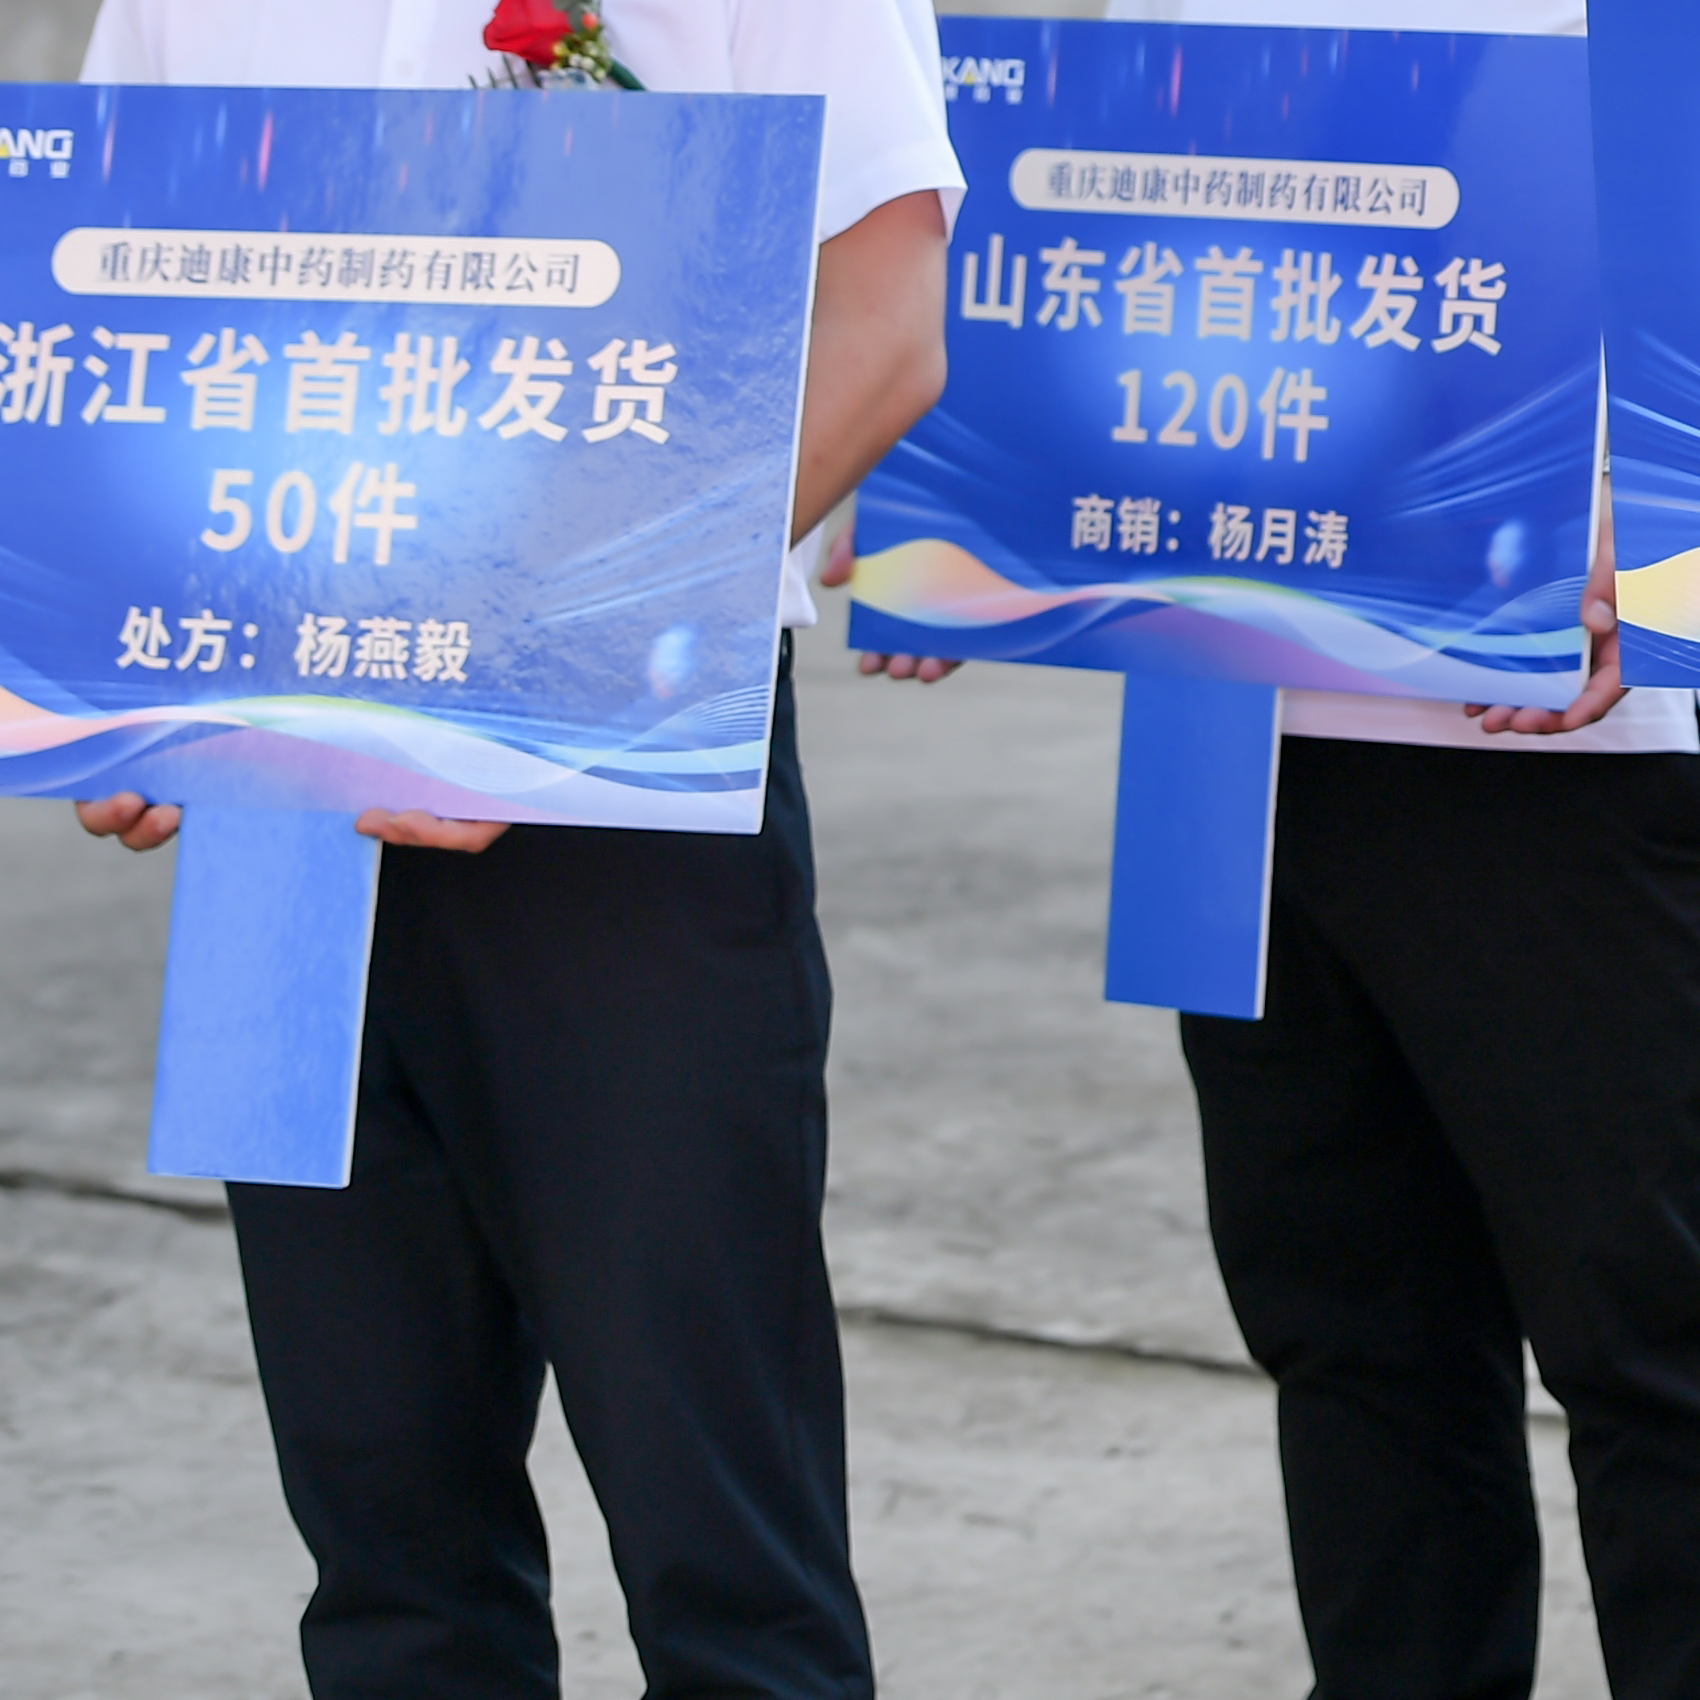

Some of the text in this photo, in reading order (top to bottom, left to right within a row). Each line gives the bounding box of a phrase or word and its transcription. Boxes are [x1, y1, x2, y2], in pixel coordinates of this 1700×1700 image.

[1047, 163, 1429, 218] 重庆迪康中药制药有限公司
[97, 241, 581, 295] 重庆迪康中药制药有限公司
[960, 234, 1506, 355] 山东省首批发货
[0, 321, 678, 444] 浙江省首批发货
[1111, 368, 1329, 462] 120件
[201, 463, 419, 565] 50件
